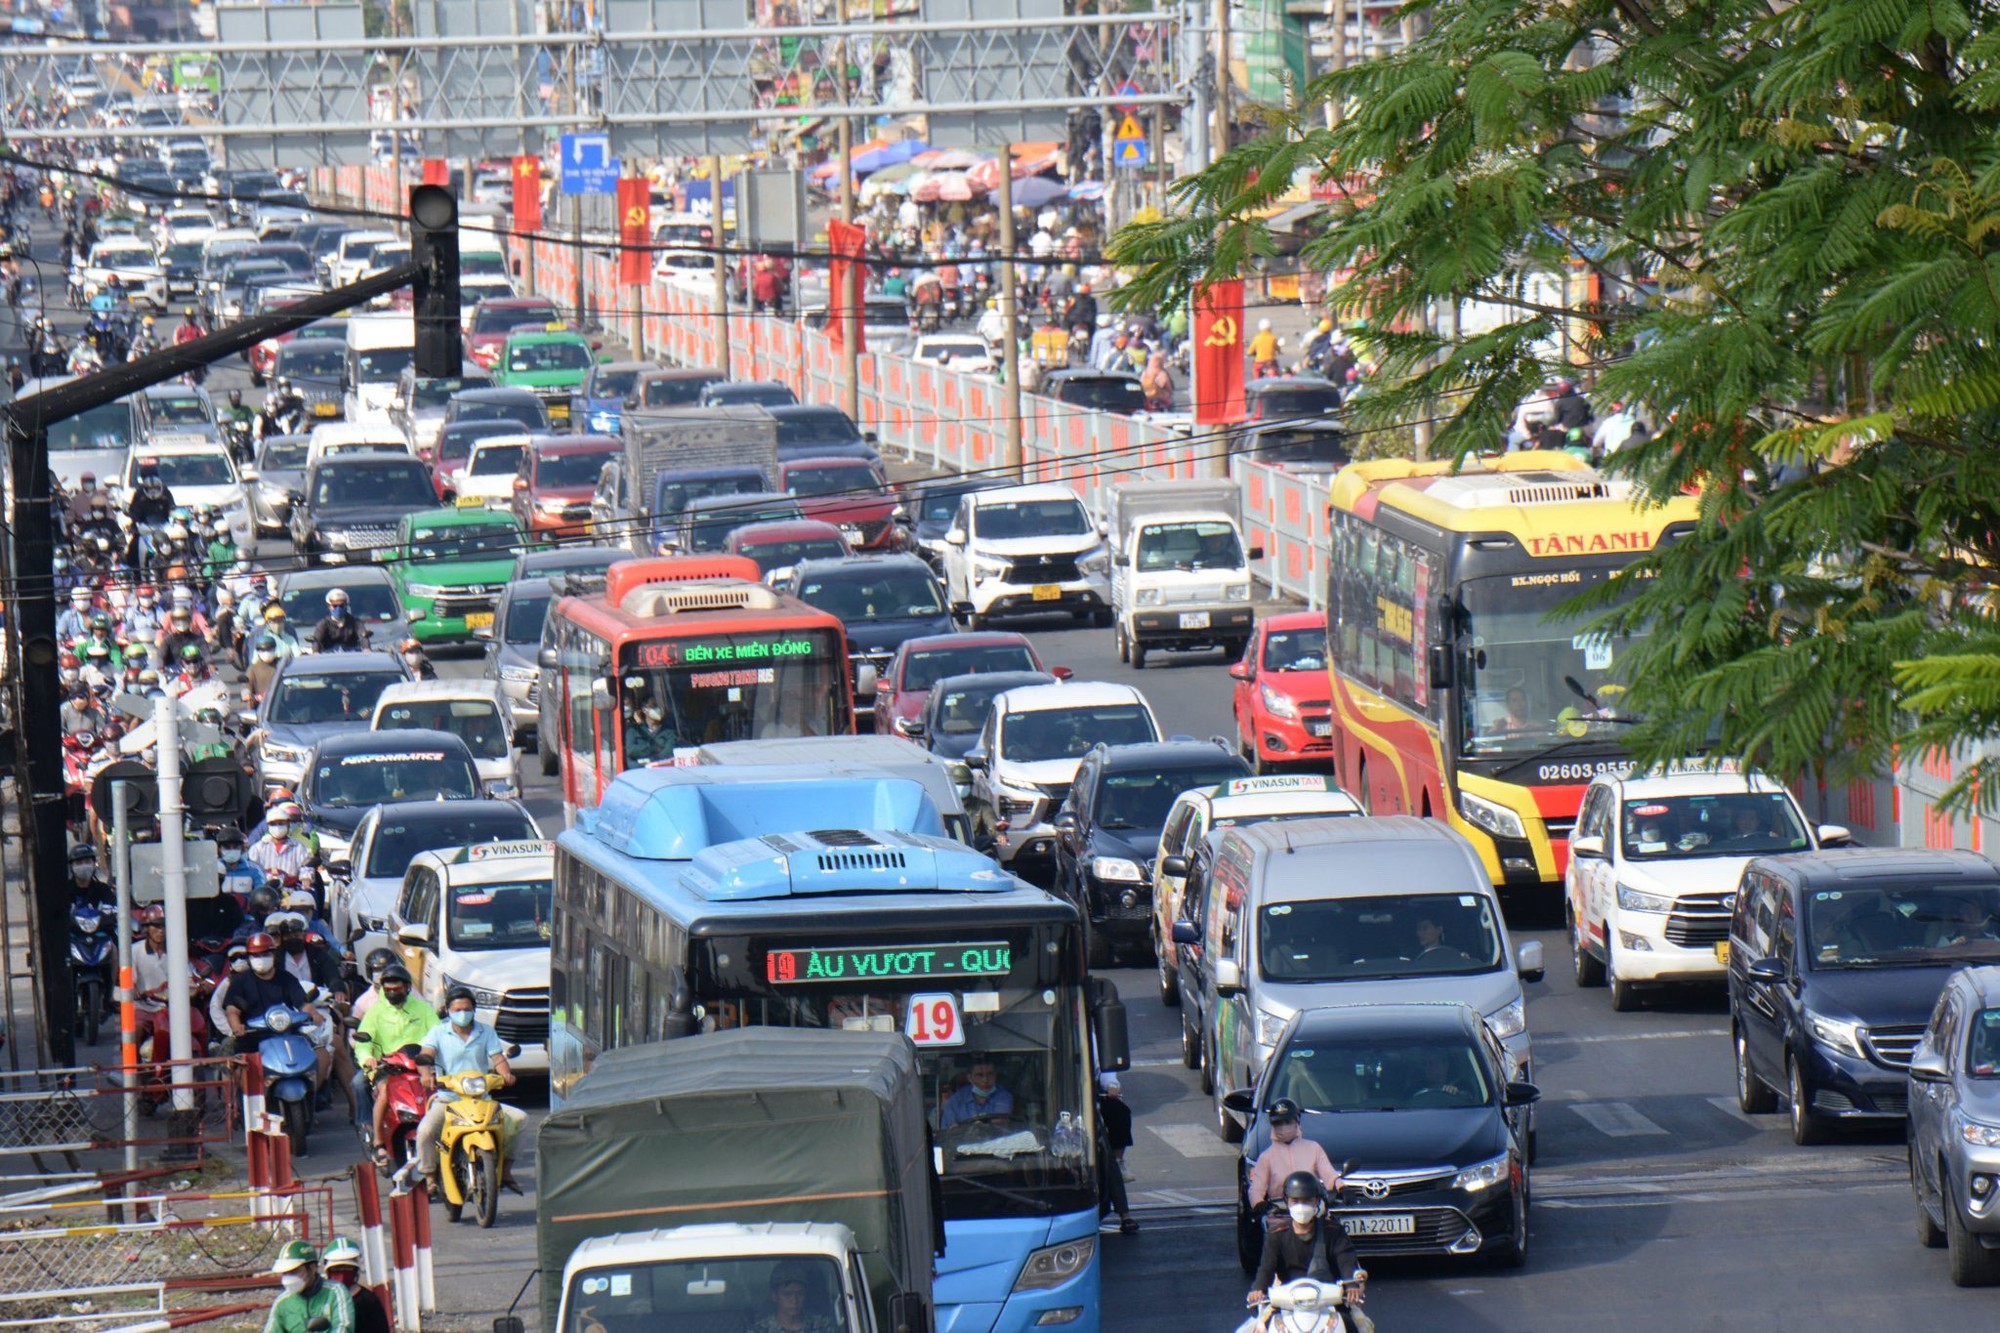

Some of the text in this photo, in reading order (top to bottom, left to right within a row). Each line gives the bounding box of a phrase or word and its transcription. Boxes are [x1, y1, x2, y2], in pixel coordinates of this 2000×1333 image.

[1528, 531, 1651, 555] TÂN ANH
[716, 646, 734, 659] XE
[341, 752, 446, 766] PERFORMANCE
[1670, 763, 1719, 773] VINASN
[491, 844, 542, 856] VINASUN
[912, 1001, 954, 1041] 19
